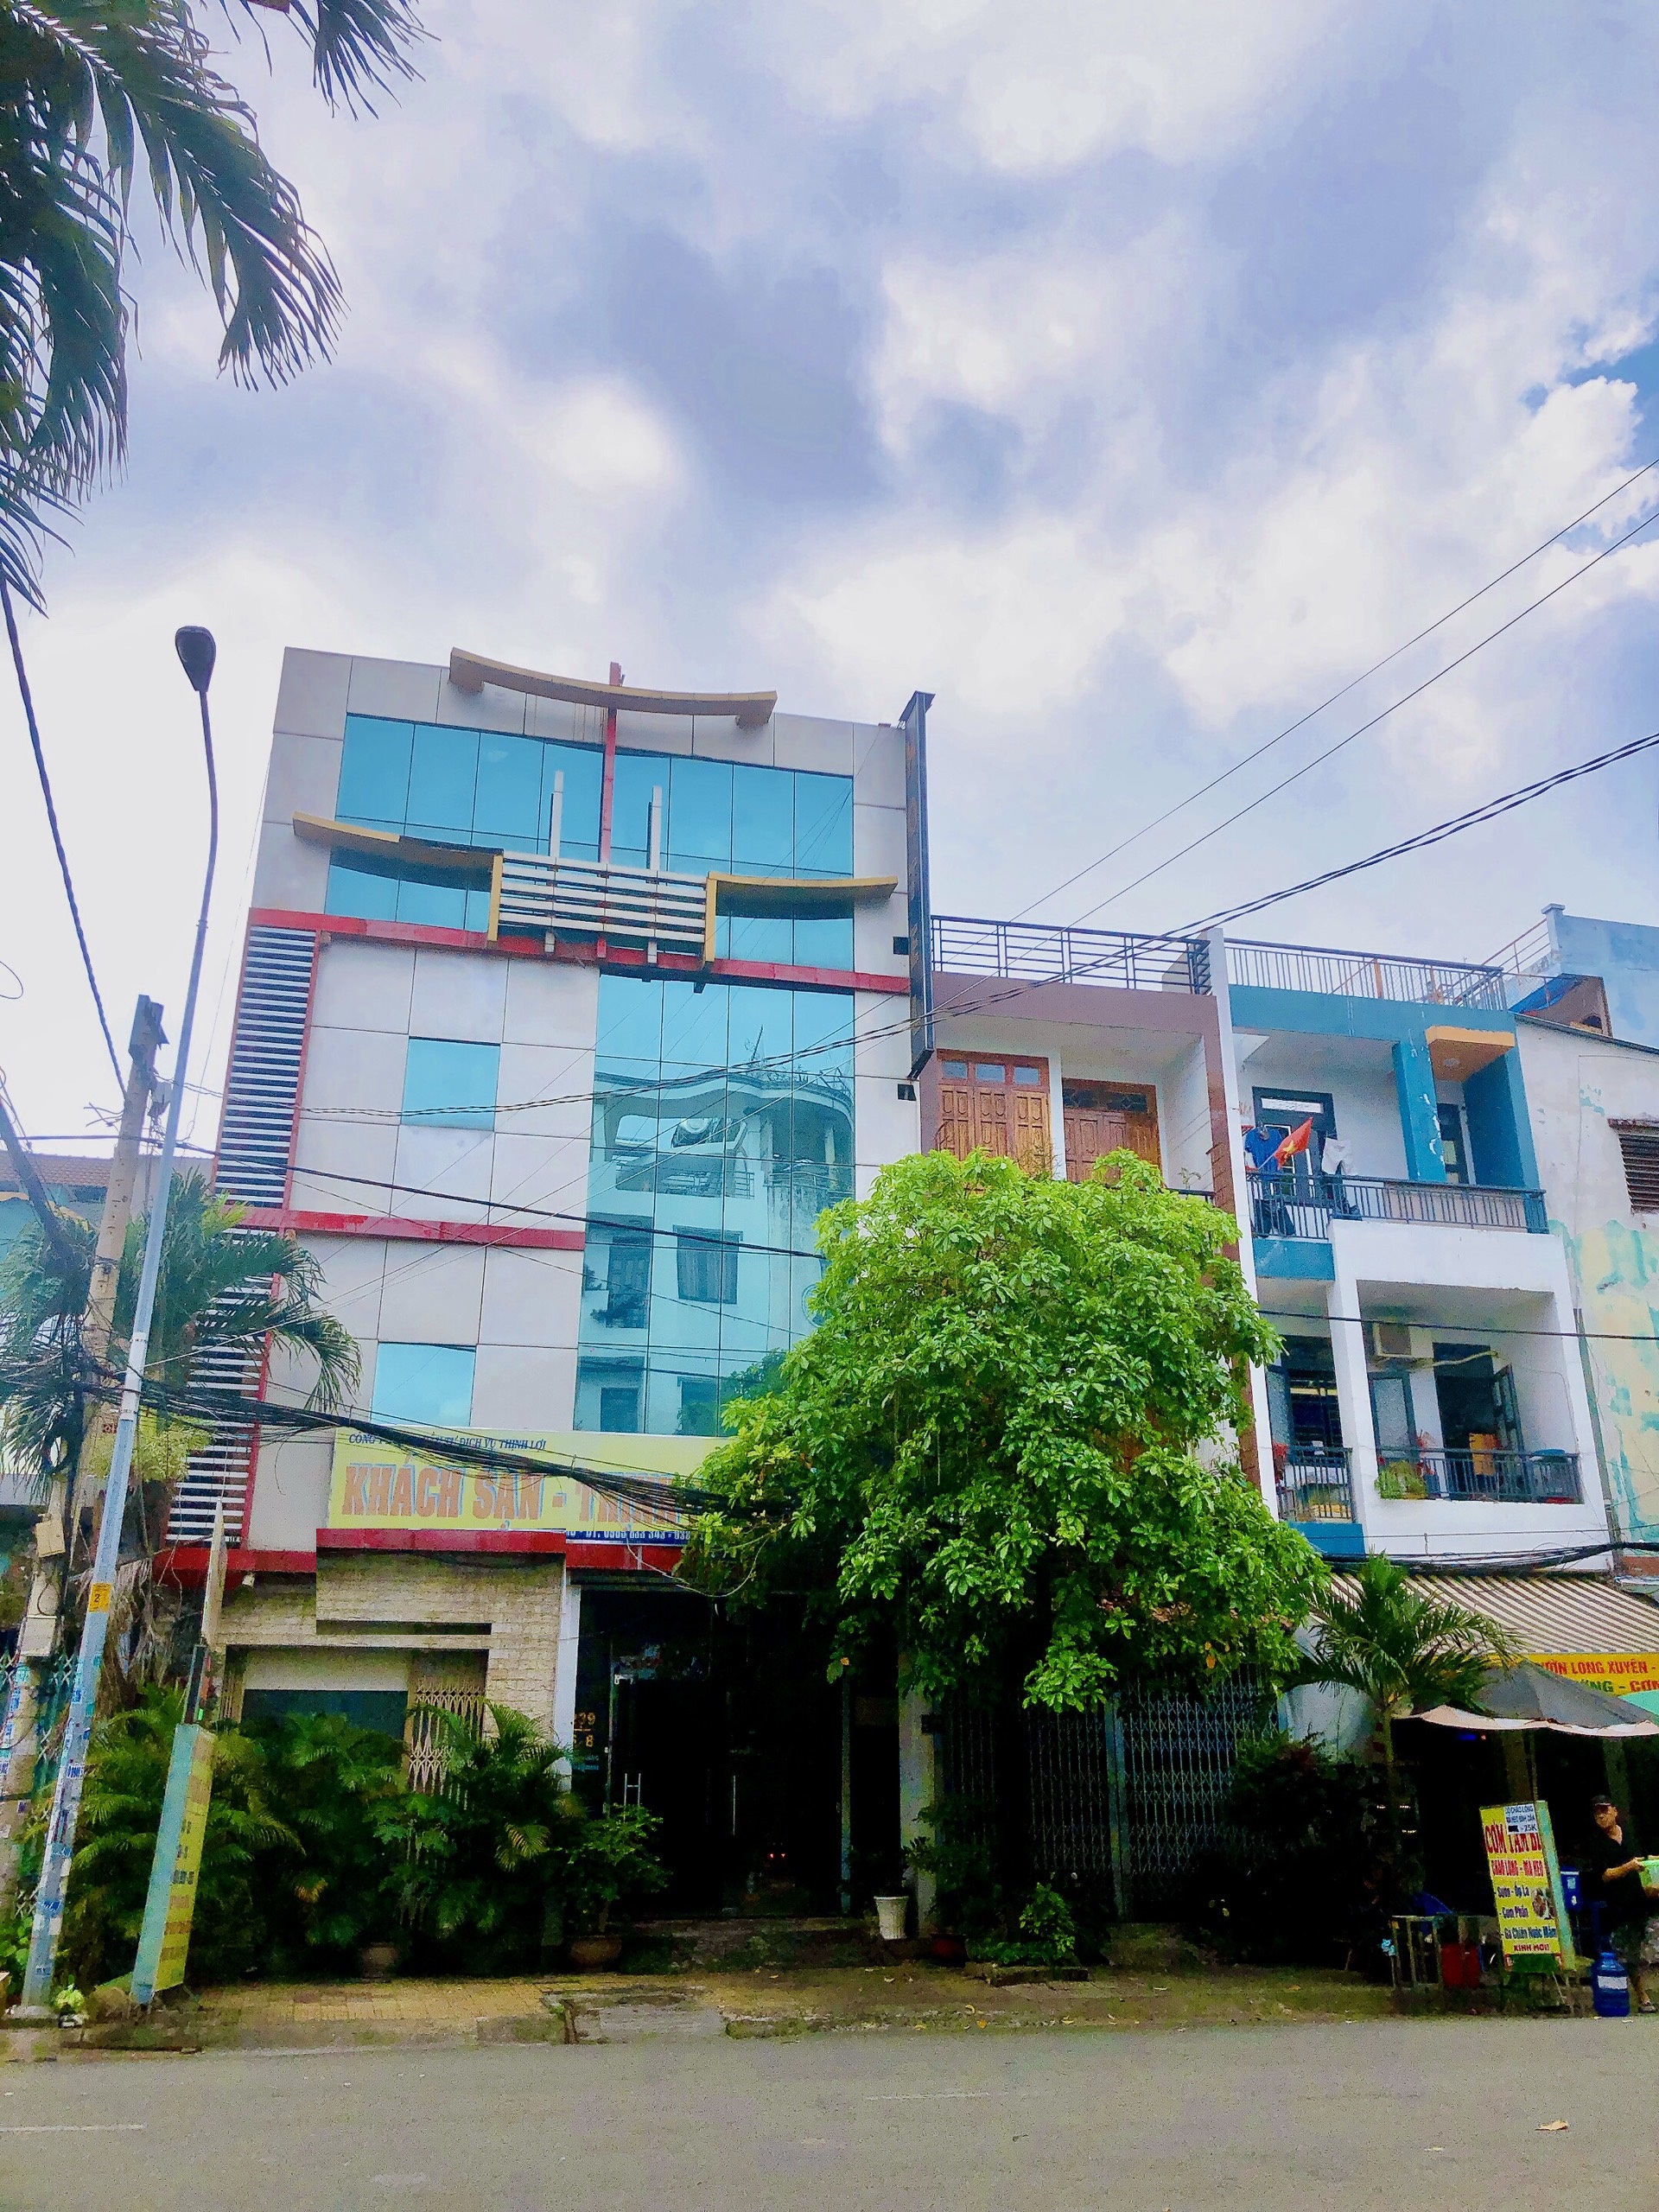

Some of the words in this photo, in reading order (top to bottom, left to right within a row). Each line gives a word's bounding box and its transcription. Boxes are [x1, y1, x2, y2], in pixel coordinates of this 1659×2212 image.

[342, 1452, 463, 1518] KHÁCH
[473, 1467, 544, 1529] SẠN
[1572, 1661, 1605, 1675] LONG
[1607, 1658, 1648, 1675] XUYÊN
